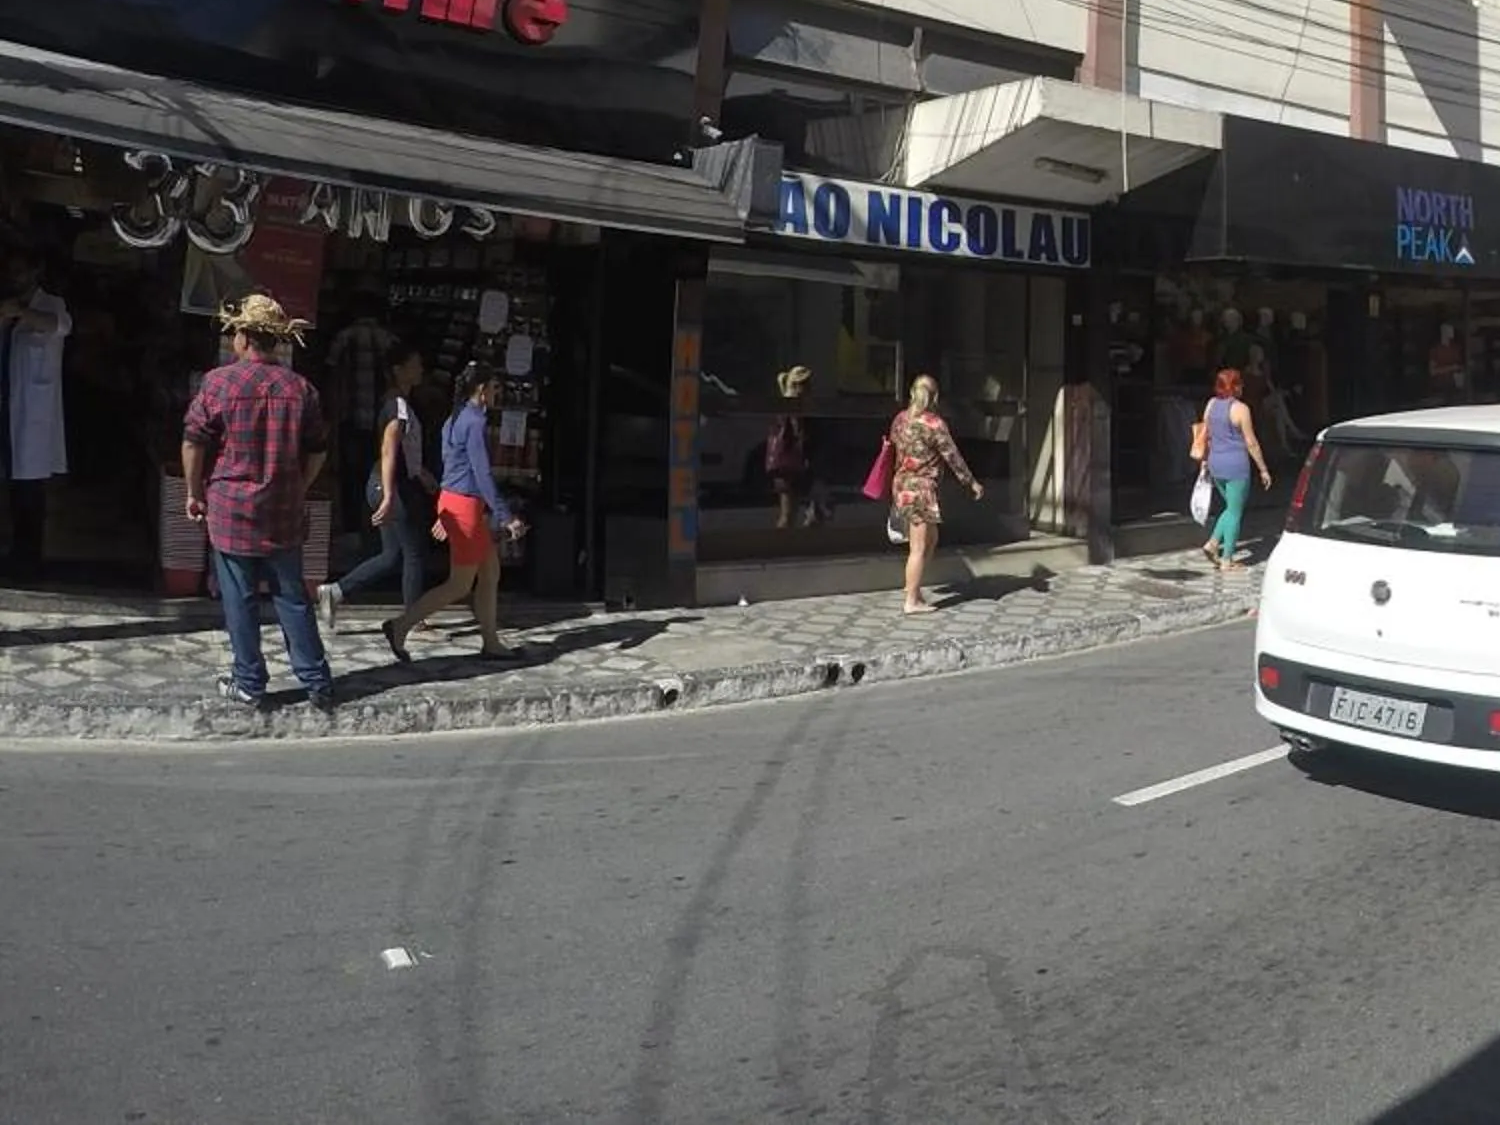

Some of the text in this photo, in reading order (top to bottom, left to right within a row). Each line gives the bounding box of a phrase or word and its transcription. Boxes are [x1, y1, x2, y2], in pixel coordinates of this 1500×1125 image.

[112, 150, 259, 253] 33
[867, 190, 1089, 264] NICOLAU
[1396, 186, 1473, 228] NORTH
[1397, 224, 1454, 262] PEAK
